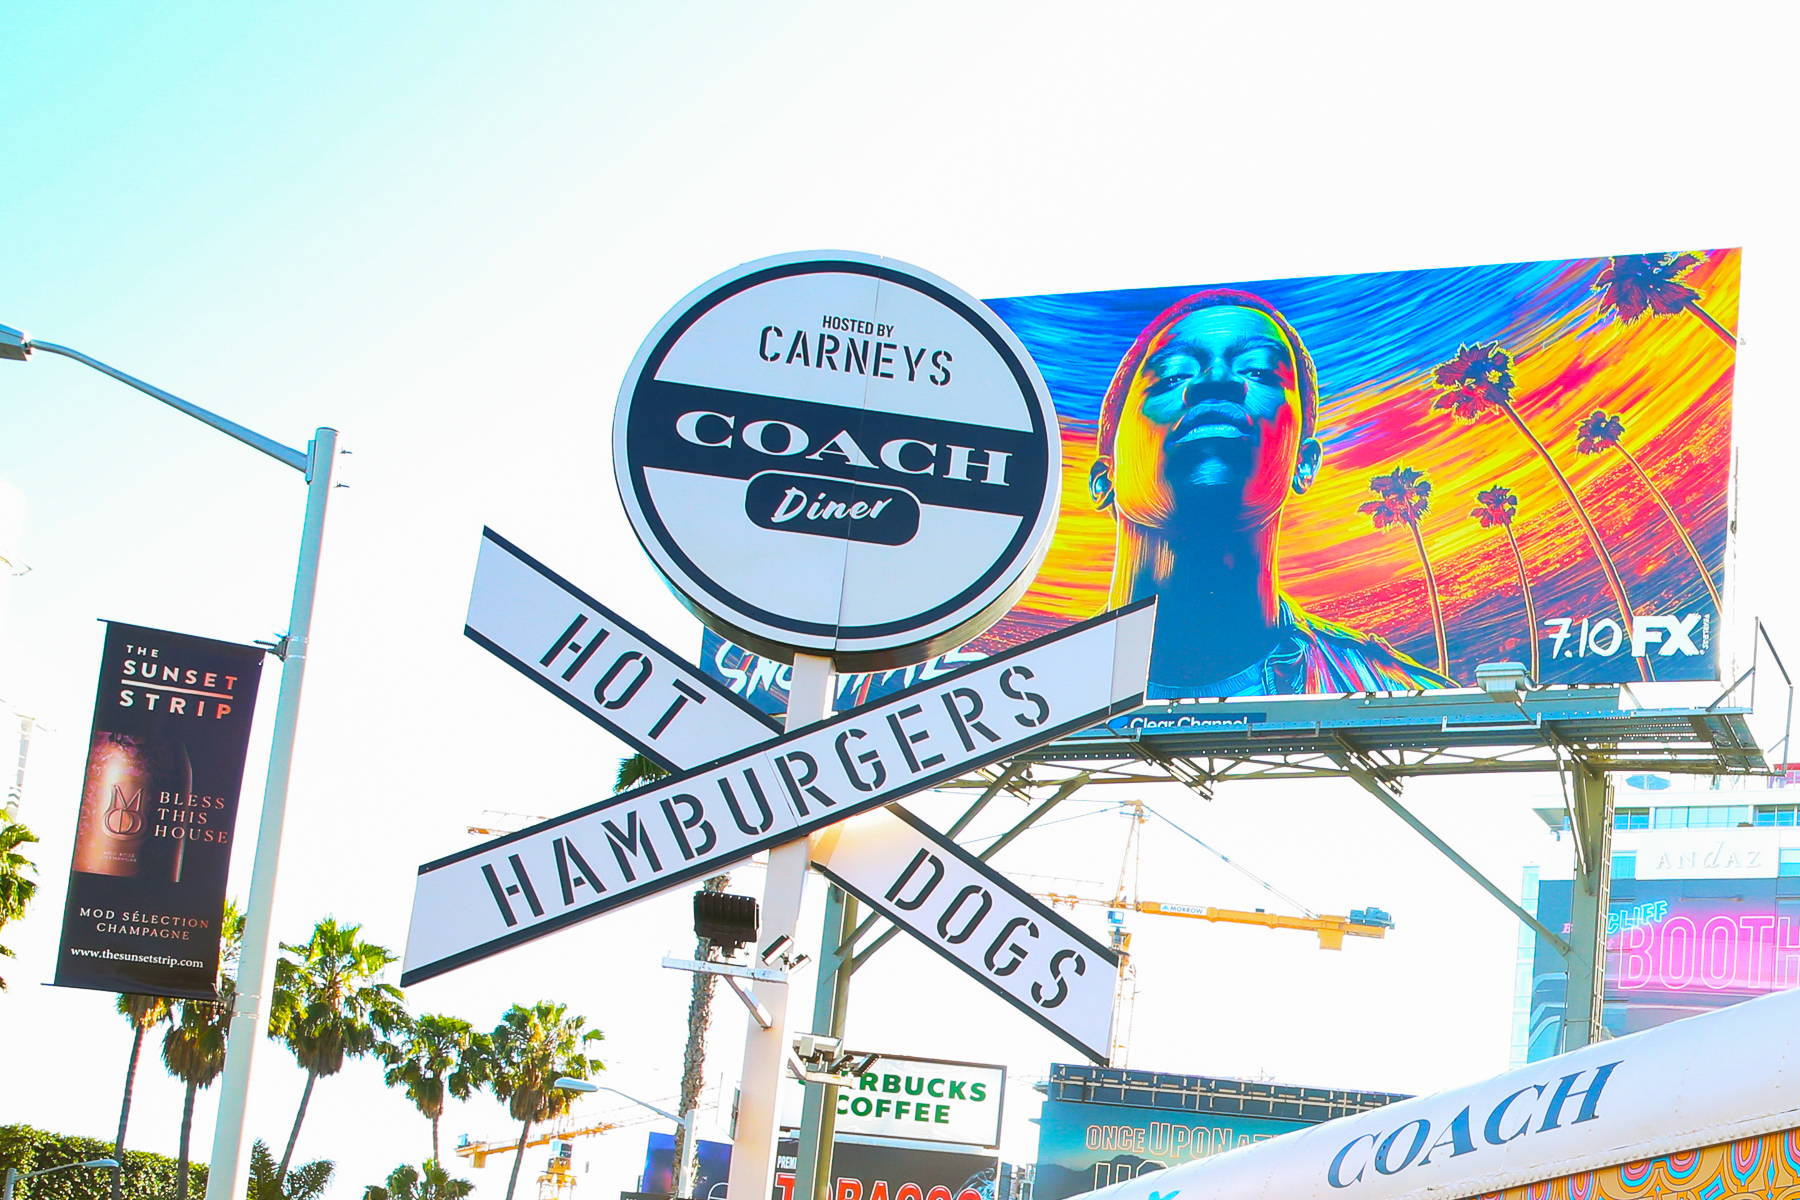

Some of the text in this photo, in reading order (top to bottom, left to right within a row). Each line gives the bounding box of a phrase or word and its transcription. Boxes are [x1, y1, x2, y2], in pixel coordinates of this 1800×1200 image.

[822, 315, 894, 338] HOSTED BY
[759, 325, 953, 387] CARNEYS
[675, 409, 1013, 487] COACH
[770, 485, 894, 523] Diner
[126, 644, 159, 659] THE
[1543, 612, 1702, 660] 7.10 FX
[123, 659, 238, 690] SUNSET
[540, 613, 707, 740] HOT
[119, 689, 232, 719] STRIP
[160, 791, 225, 810] BLESS
[481, 665, 1050, 929] HAMBURGERS
[158, 808, 208, 825] THIS
[154, 824, 228, 844] HOUSE
[79, 907, 209, 929] MOD SÉLECTION
[1170, 906, 1203, 914] MORROW
[1606, 900, 1668, 934] CLIFF
[96, 922, 190, 941] CHAMPAGNE
[884, 848, 1086, 1009] DOGS
[70, 947, 204, 968] www.thesunsetstrip.com
[835, 1070, 986, 1102] RBUCKS
[836, 1094, 950, 1124] COFFEE
[1327, 1059, 1625, 1189] COACH
[1085, 1124, 1146, 1153] ONCE
[1148, 1121, 1233, 1160] UPON
